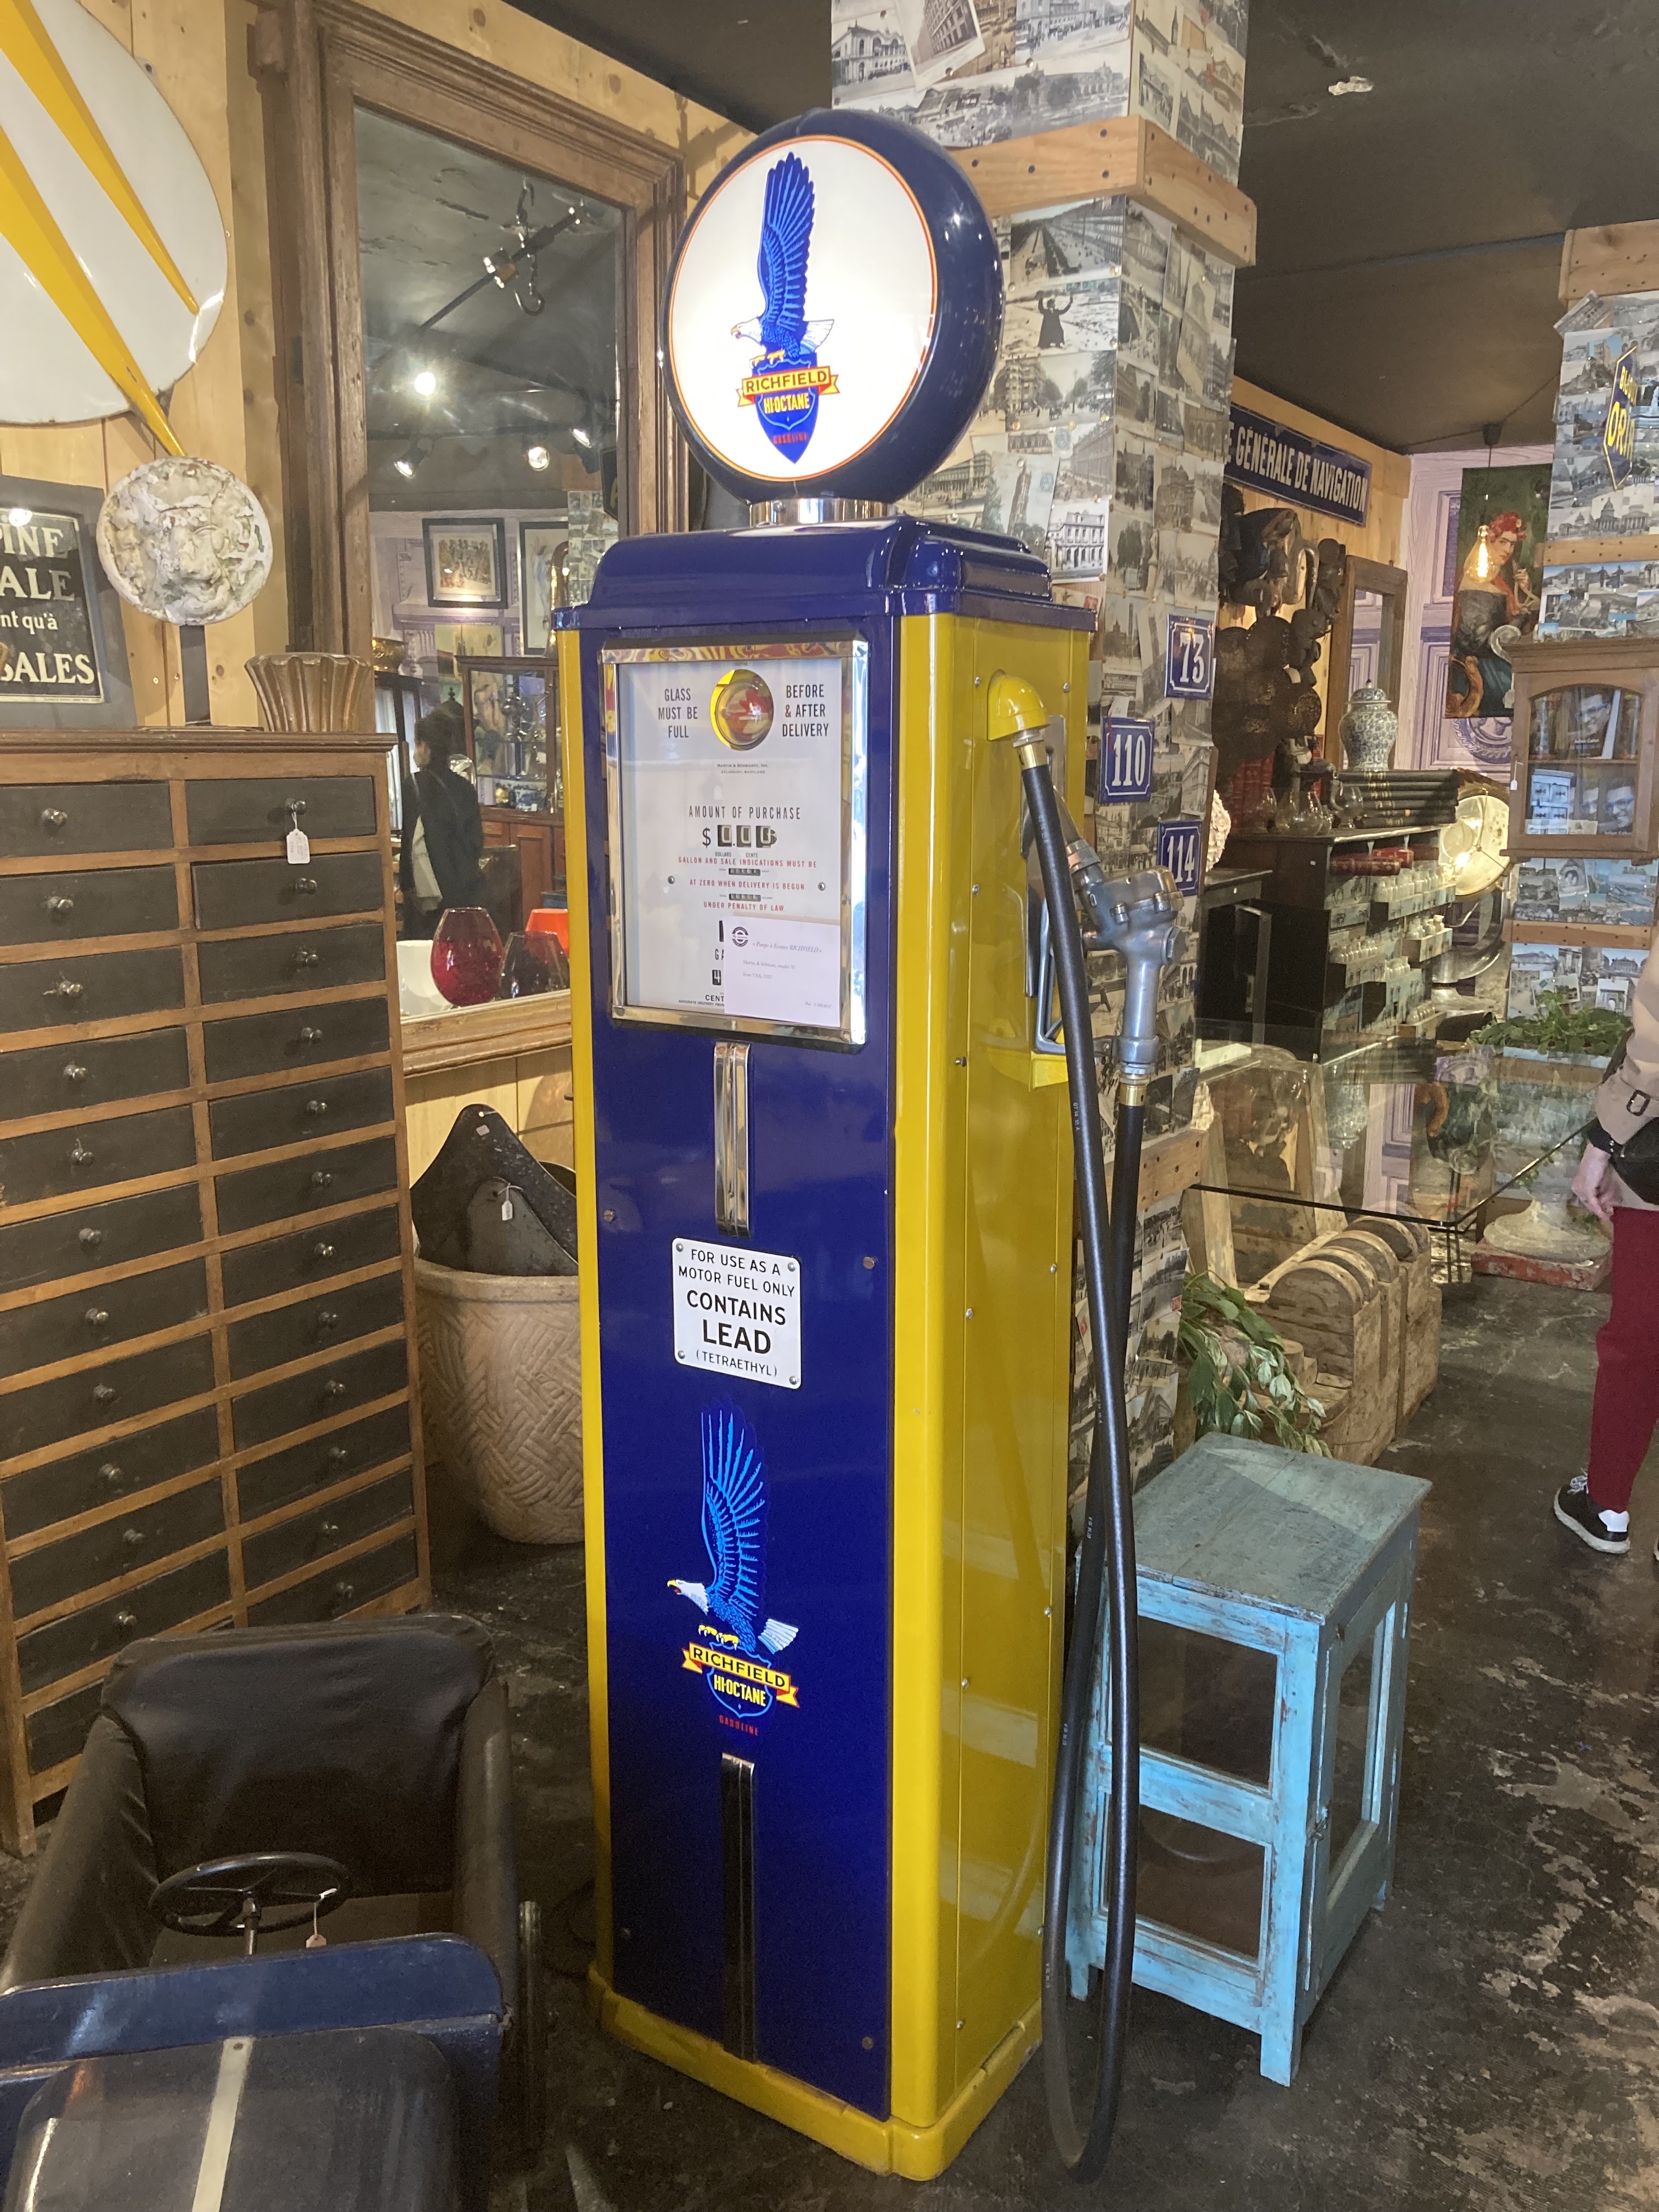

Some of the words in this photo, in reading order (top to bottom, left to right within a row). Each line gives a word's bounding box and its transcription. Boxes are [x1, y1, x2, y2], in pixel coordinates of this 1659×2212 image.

[746, 370, 827, 393] RICHFIELD
[1294, 451, 1311, 491] DE
[1310, 458, 1368, 512] NAVIGATION
[0, 523, 69, 558] INE
[1180, 632, 1204, 683] 73
[664, 688, 691, 701] GLASS
[786, 684, 824, 698] BEFORE
[658, 707, 680, 720] MUST
[687, 707, 698, 719] BE
[785, 704, 791, 718] &
[795, 704, 826, 718] AFTER
[668, 725, 689, 738] FULL
[782, 723, 829, 737] DELIVERY
[1111, 733, 1146, 787] 110
[689, 805, 725, 818] AMOUNT
[732, 806, 742, 819] OF
[749, 806, 800, 820] PURCHASE
[702, 827, 711, 848] $
[1167, 834, 1195, 882] 114
[691, 1249, 714, 1263] FOR
[720, 1254, 744, 1269] USE
[750, 1260, 766, 1273] AS
[772, 1263, 780, 1276] A
[679, 1266, 721, 1283] MOTOR
[727, 1274, 758, 1290] FUEL
[763, 1281, 794, 1297] ONLY
[687, 1290, 786, 1325] CONTAINS
[703, 1319, 771, 1354] LEAD
[696, 1349, 777, 1377] (TETRAETHYL)
[693, 1647, 785, 1688] RICHFIELD
